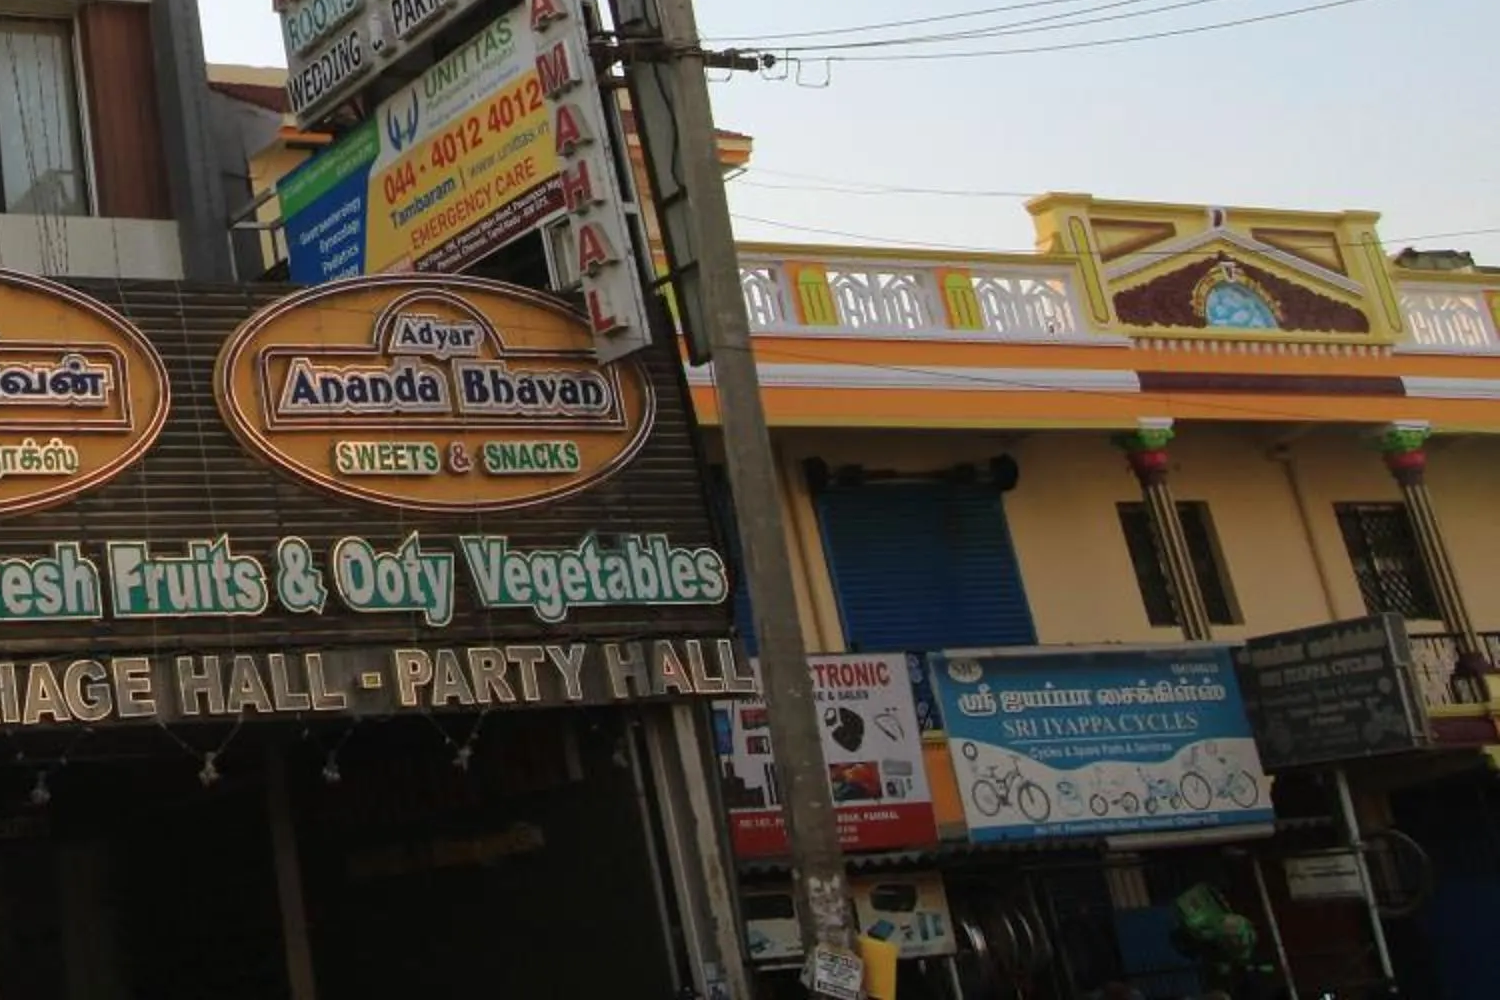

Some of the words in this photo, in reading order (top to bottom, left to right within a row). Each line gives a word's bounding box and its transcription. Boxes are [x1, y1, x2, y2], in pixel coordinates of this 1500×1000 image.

[288, 31, 362, 112] WEDDING
[384, 160, 416, 205] 044
[431, 116, 483, 168] 4012
[488, 77, 542, 133] 4012
[390, 177, 456, 229] Tambaram
[411, 182, 492, 248] EMERGENCY
[495, 156, 536, 197] CARE
[400, 320, 476, 351] Adyar
[291, 366, 441, 405] Ananda
[463, 366, 603, 406] Bhavan
[338, 443, 439, 472] SWEETS
[449, 442, 471, 473] &
[483, 442, 580, 471] SNACKS
[107, 534, 268, 617] Fruits
[278, 536, 327, 614] &
[334, 531, 454, 626] Ooty
[460, 531, 727, 623] Vegetables
[177, 654, 347, 715] HALL
[395, 644, 586, 706] PARTY
[606, 640, 756, 698] HALL
[812, 661, 891, 688] TRONIC
[1002, 717, 1038, 738] SRI
[1044, 715, 1117, 736] IYAPPA
[1118, 711, 1199, 732] CYCLES
